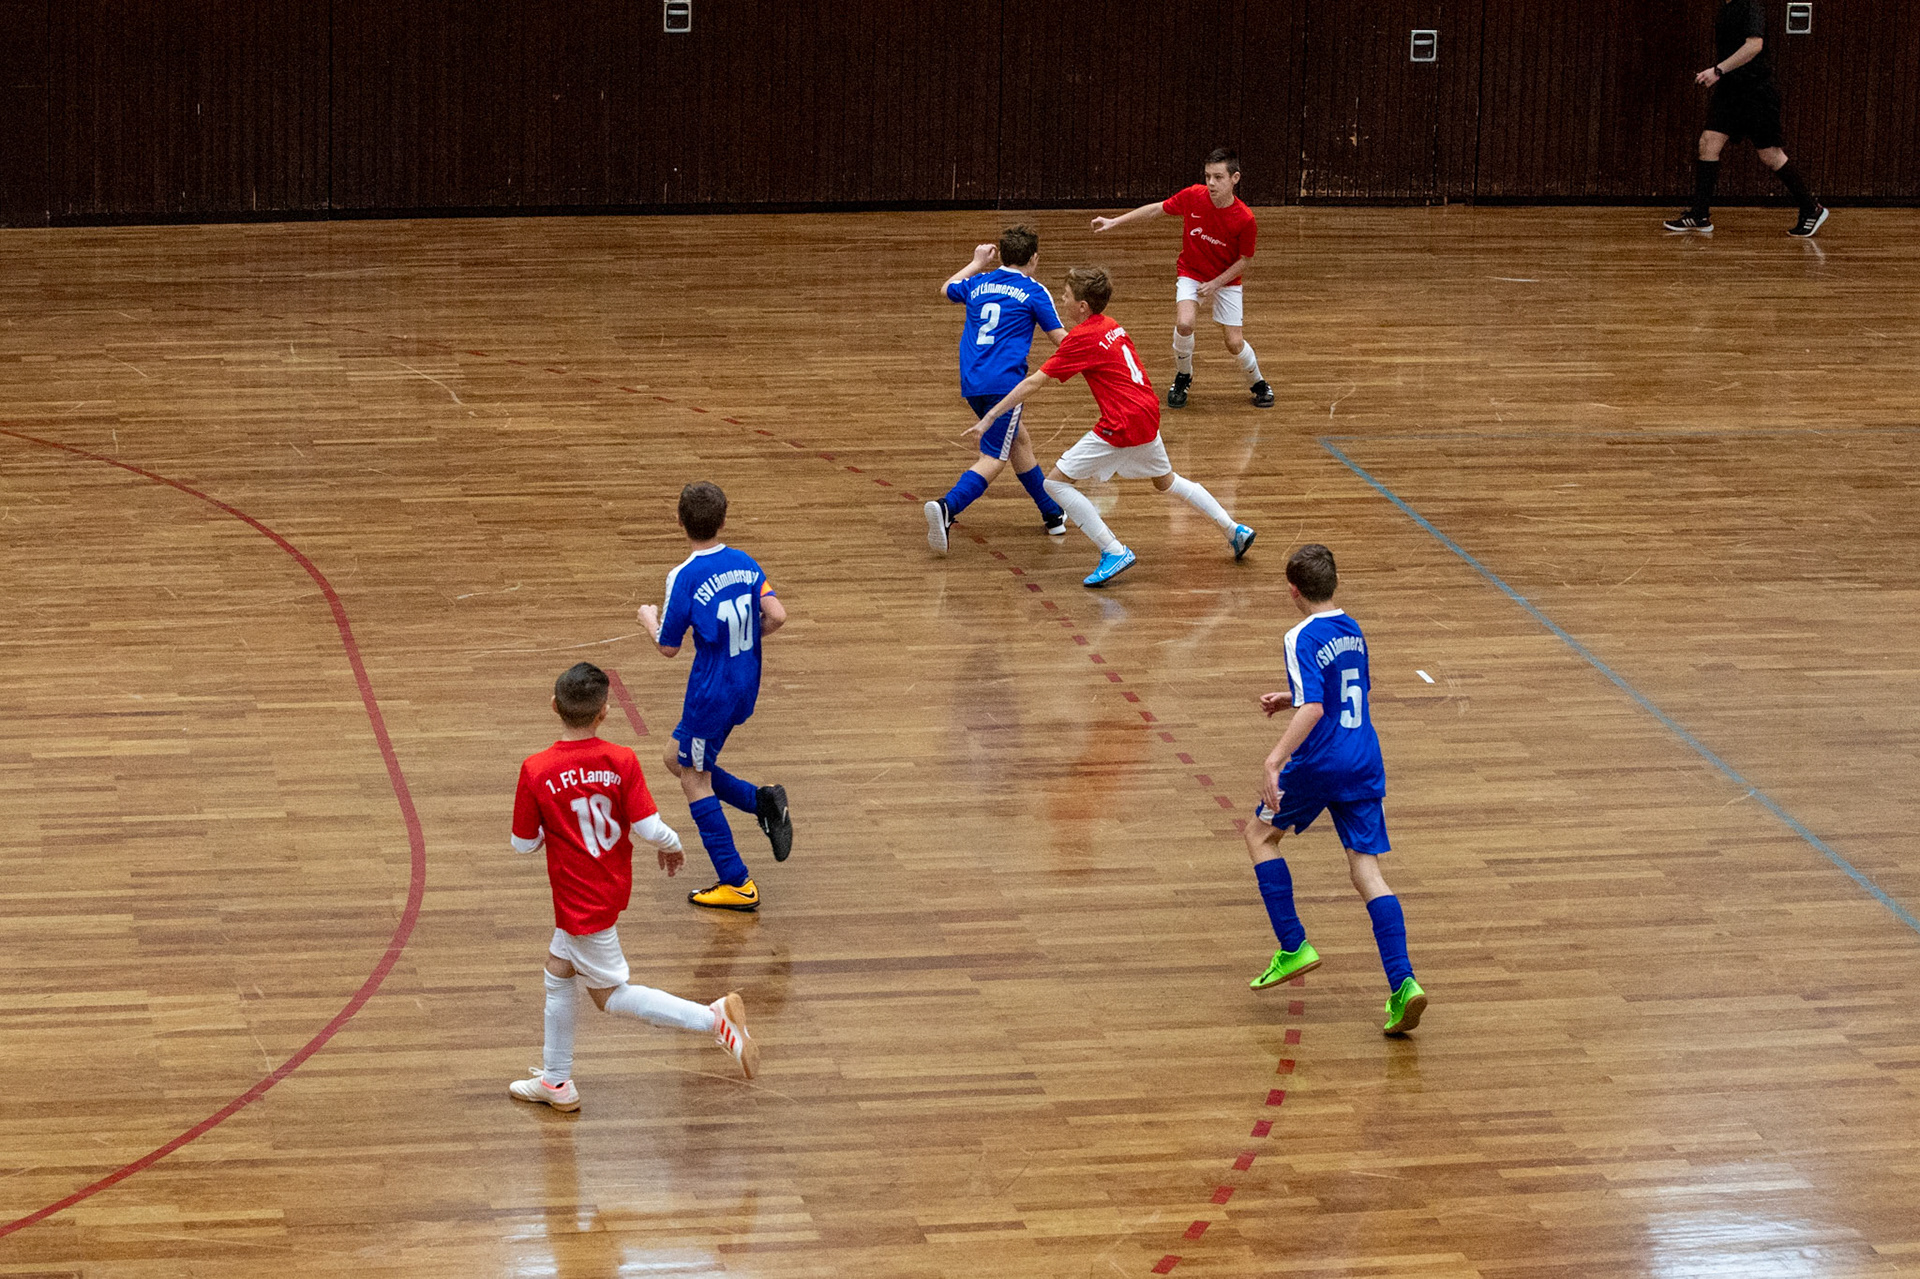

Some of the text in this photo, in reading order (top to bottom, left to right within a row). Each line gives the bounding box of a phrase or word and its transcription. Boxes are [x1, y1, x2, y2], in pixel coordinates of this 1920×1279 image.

[980, 281, 1030, 303] Lämmerspiel
[976, 302, 1001, 345] 2
[693, 568, 759, 606] TSV Lämmerspl
[716, 593, 754, 657] 10
[1339, 667, 1363, 729] 5
[545, 767, 622, 794] 1. FC Langen
[570, 793, 622, 858] 10
